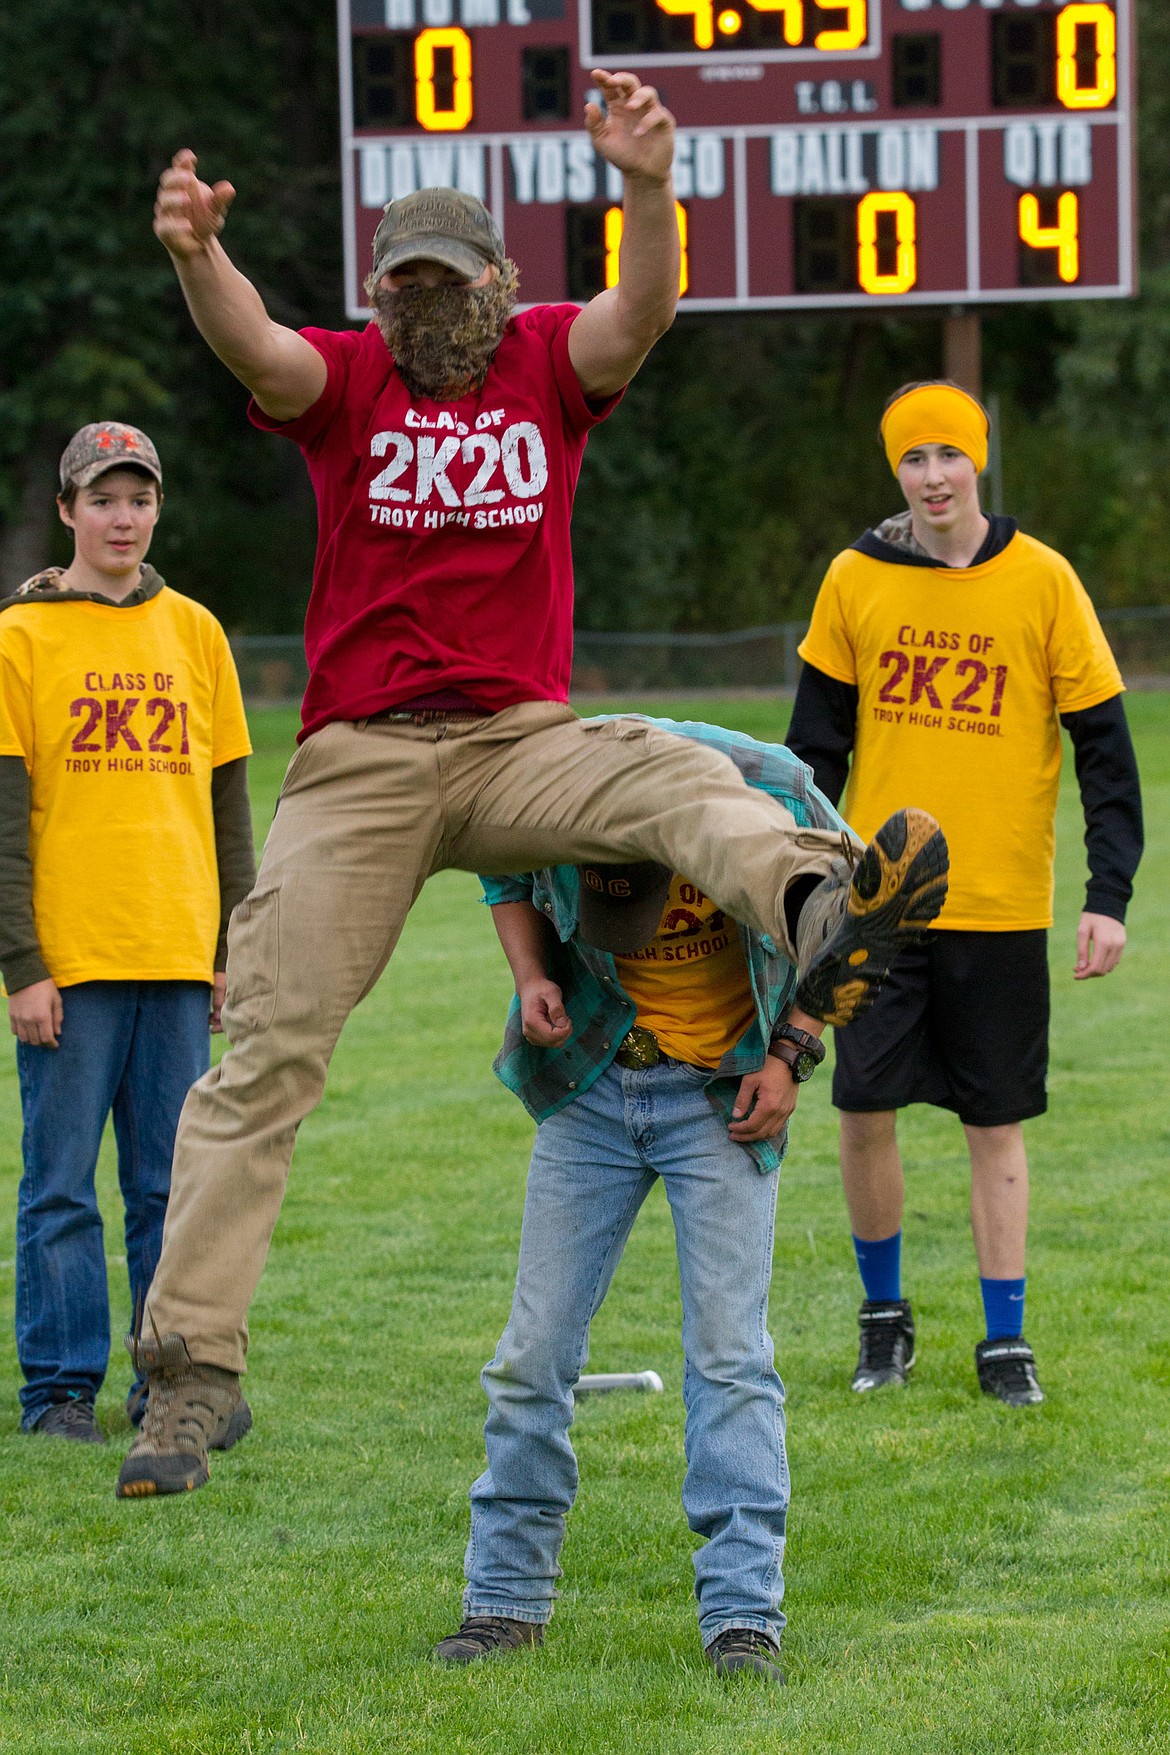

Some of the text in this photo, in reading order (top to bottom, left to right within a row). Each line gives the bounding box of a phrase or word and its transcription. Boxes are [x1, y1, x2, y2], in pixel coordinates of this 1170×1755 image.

[413, 26, 473, 131] 0
[1055, 3, 1117, 109] 0
[360, 142, 487, 209] DOWN
[508, 136, 598, 204] YDS
[770, 127, 940, 196] BALL ON
[1004, 119, 1092, 187] QTR
[857, 191, 917, 295] 0
[1018, 191, 1079, 283] 4
[475, 408, 506, 431] OF
[368, 421, 549, 508] 2K20
[368, 503, 420, 529] TROY
[898, 625, 995, 655] CLASS OF
[84, 671, 175, 692] CLASS OF
[878, 650, 1008, 717] 2K21
[69, 697, 190, 755] 2K21
[873, 707, 1005, 738] TROY HIGH SCHOOL
[65, 757, 196, 776] TROY HIGH SCHOOL
